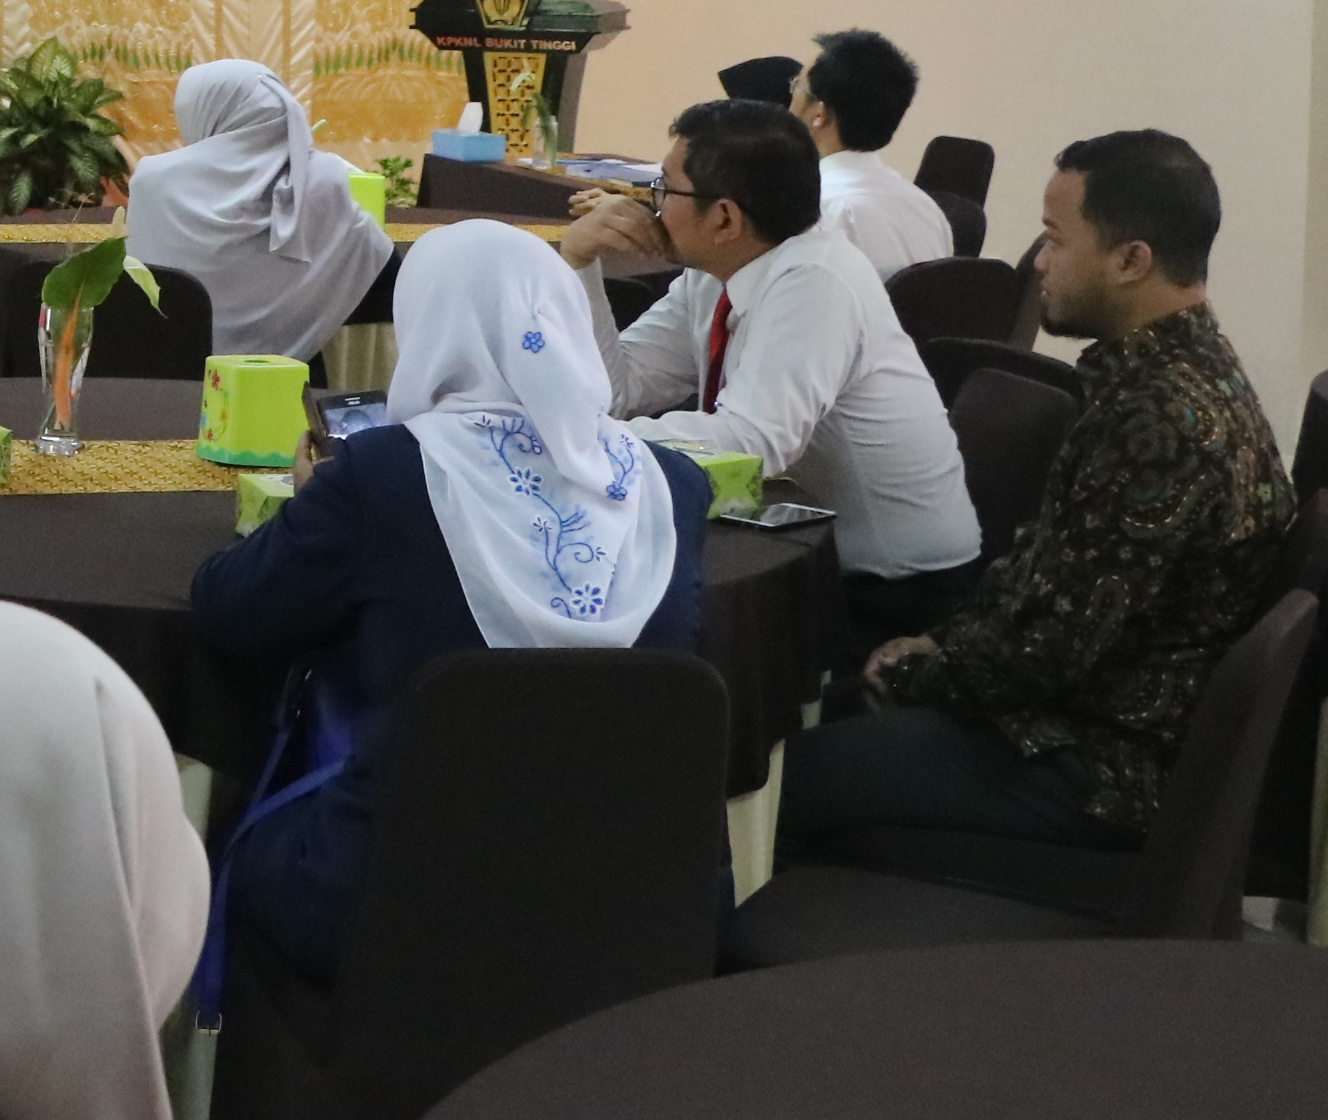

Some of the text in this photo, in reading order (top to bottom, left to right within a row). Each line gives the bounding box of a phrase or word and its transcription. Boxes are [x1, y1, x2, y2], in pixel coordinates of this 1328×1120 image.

[436, 36, 577, 51] KPKNL BUKIT TINGGI
